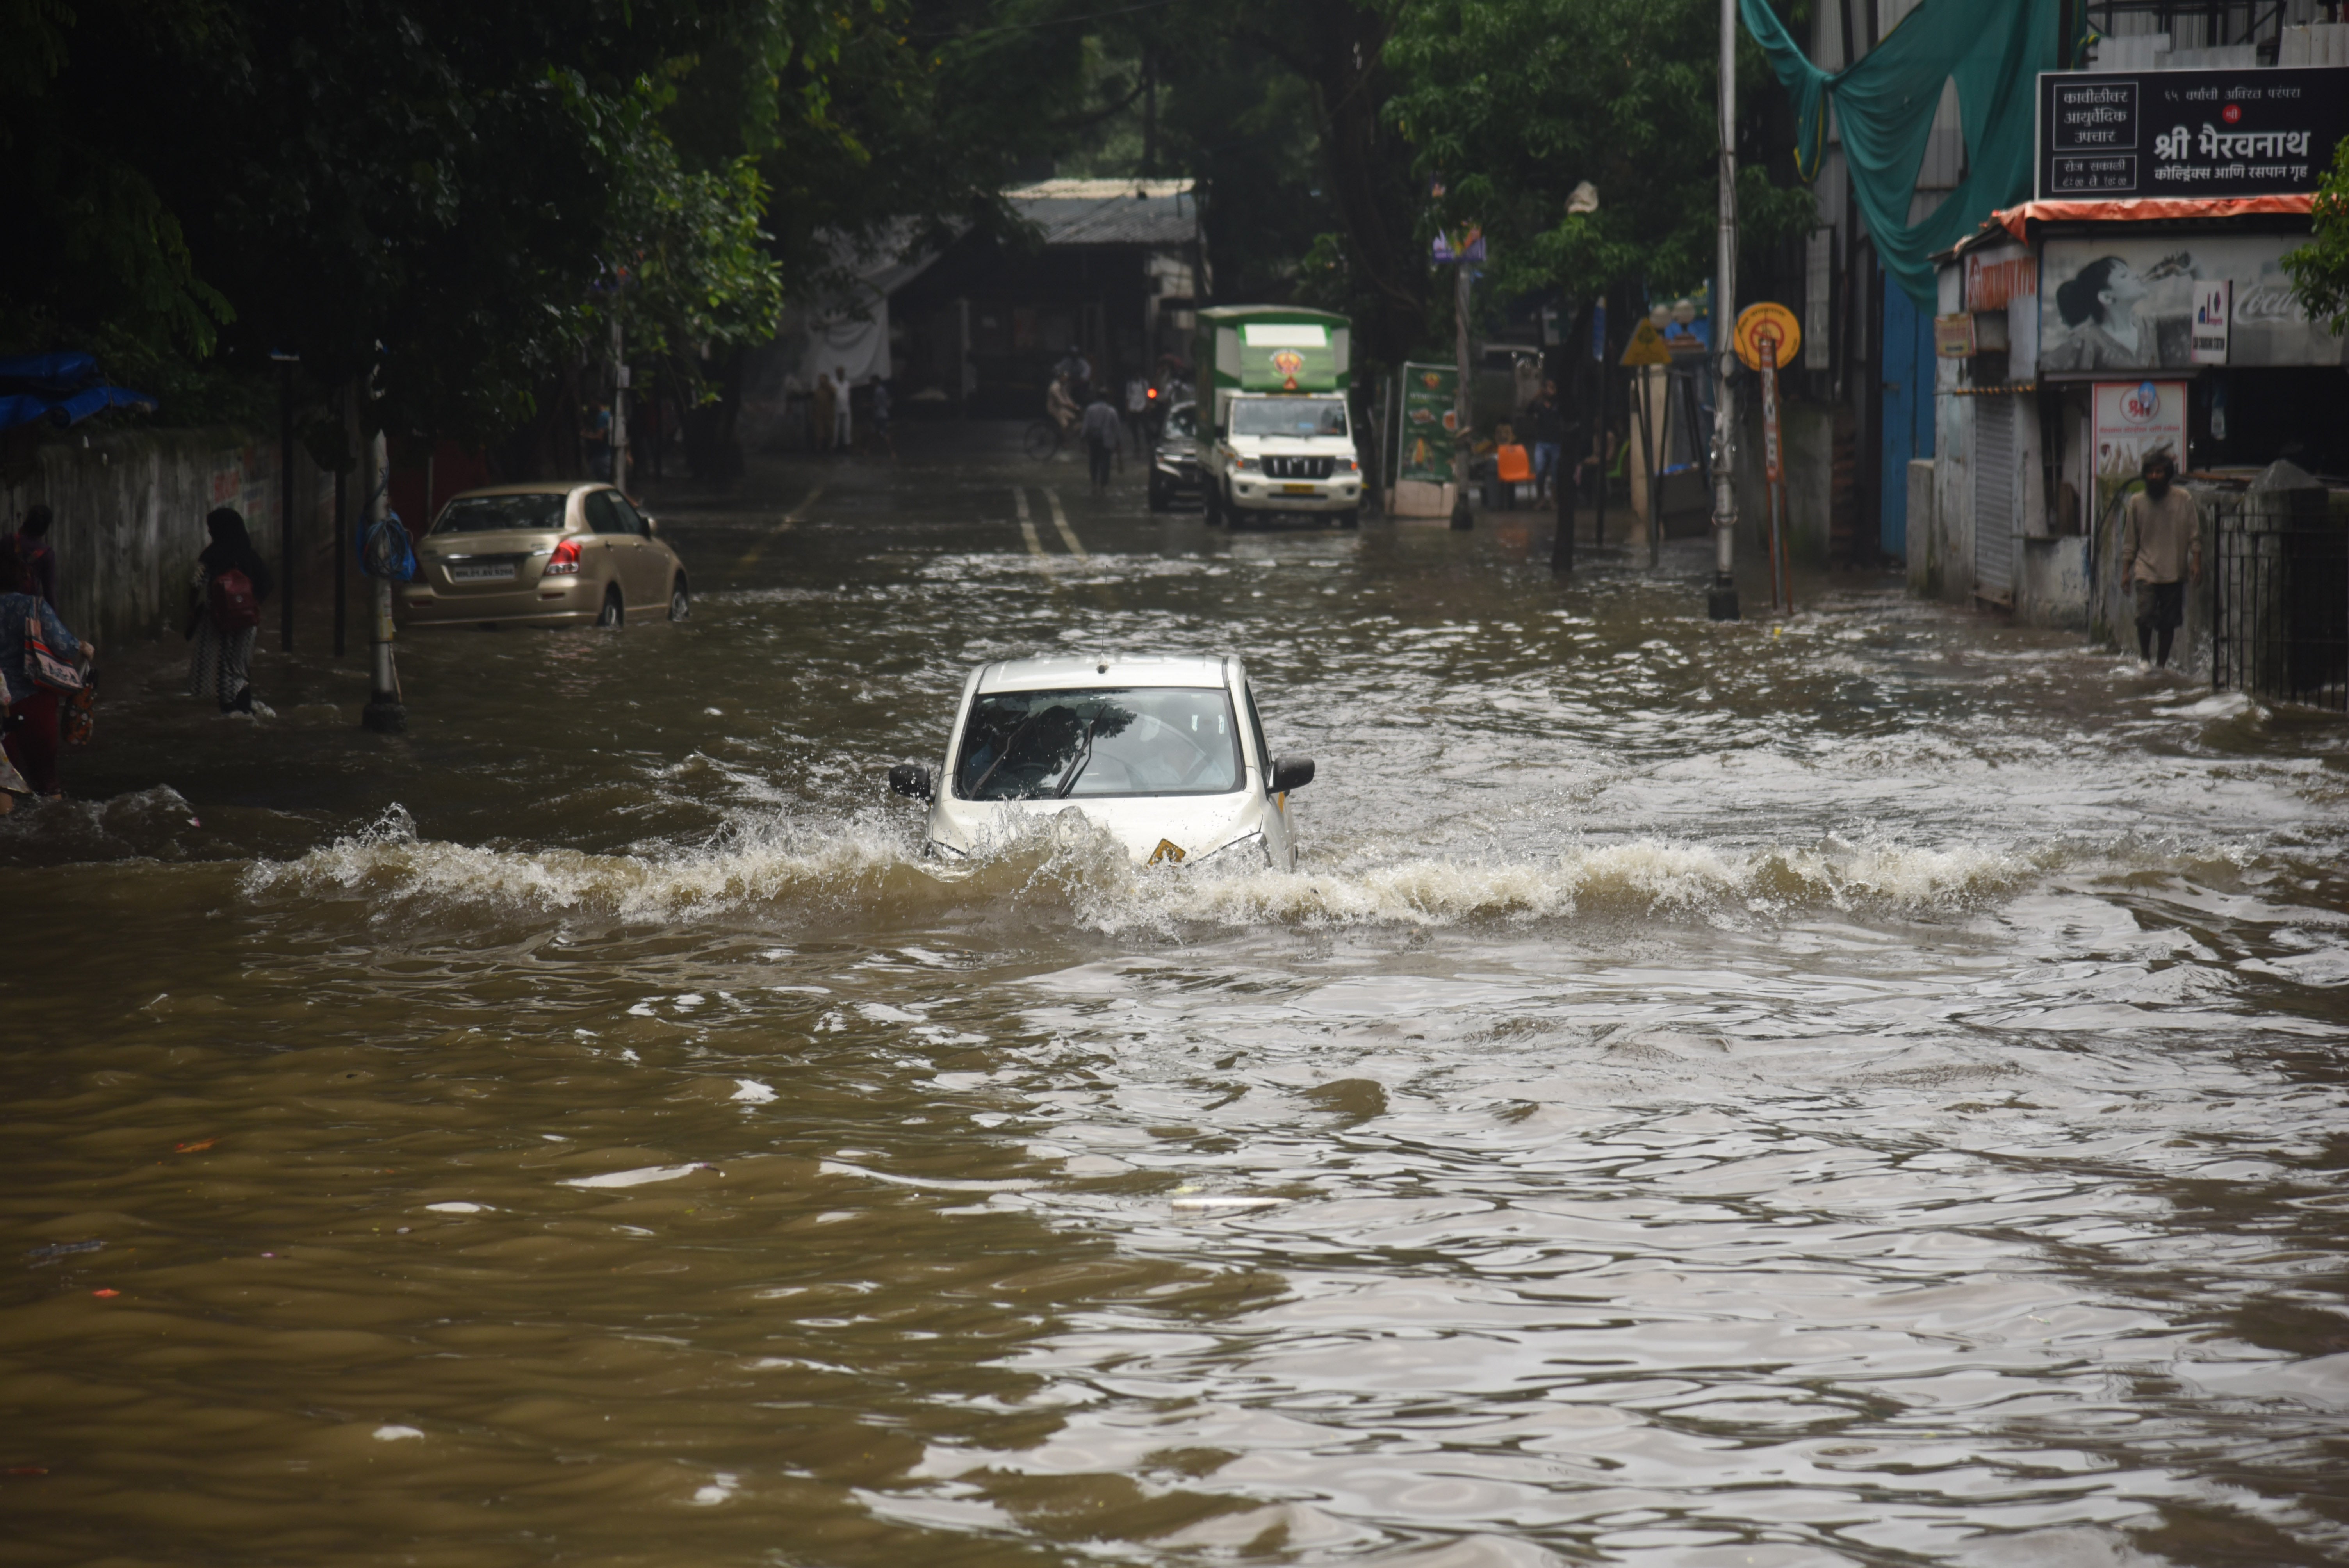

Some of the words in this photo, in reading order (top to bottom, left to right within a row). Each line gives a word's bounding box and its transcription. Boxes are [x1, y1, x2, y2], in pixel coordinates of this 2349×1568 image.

[2268, 85, 2301, 98] परंपरा
[2075, 130, 2116, 143] उपचार
[2153, 125, 2191, 160] श्री
[2198, 123, 2311, 159] भैरवनाथ
[2214, 162, 2246, 179] आणि
[2248, 165, 2287, 178] रसपान
[2290, 165, 2308, 182] गृह
